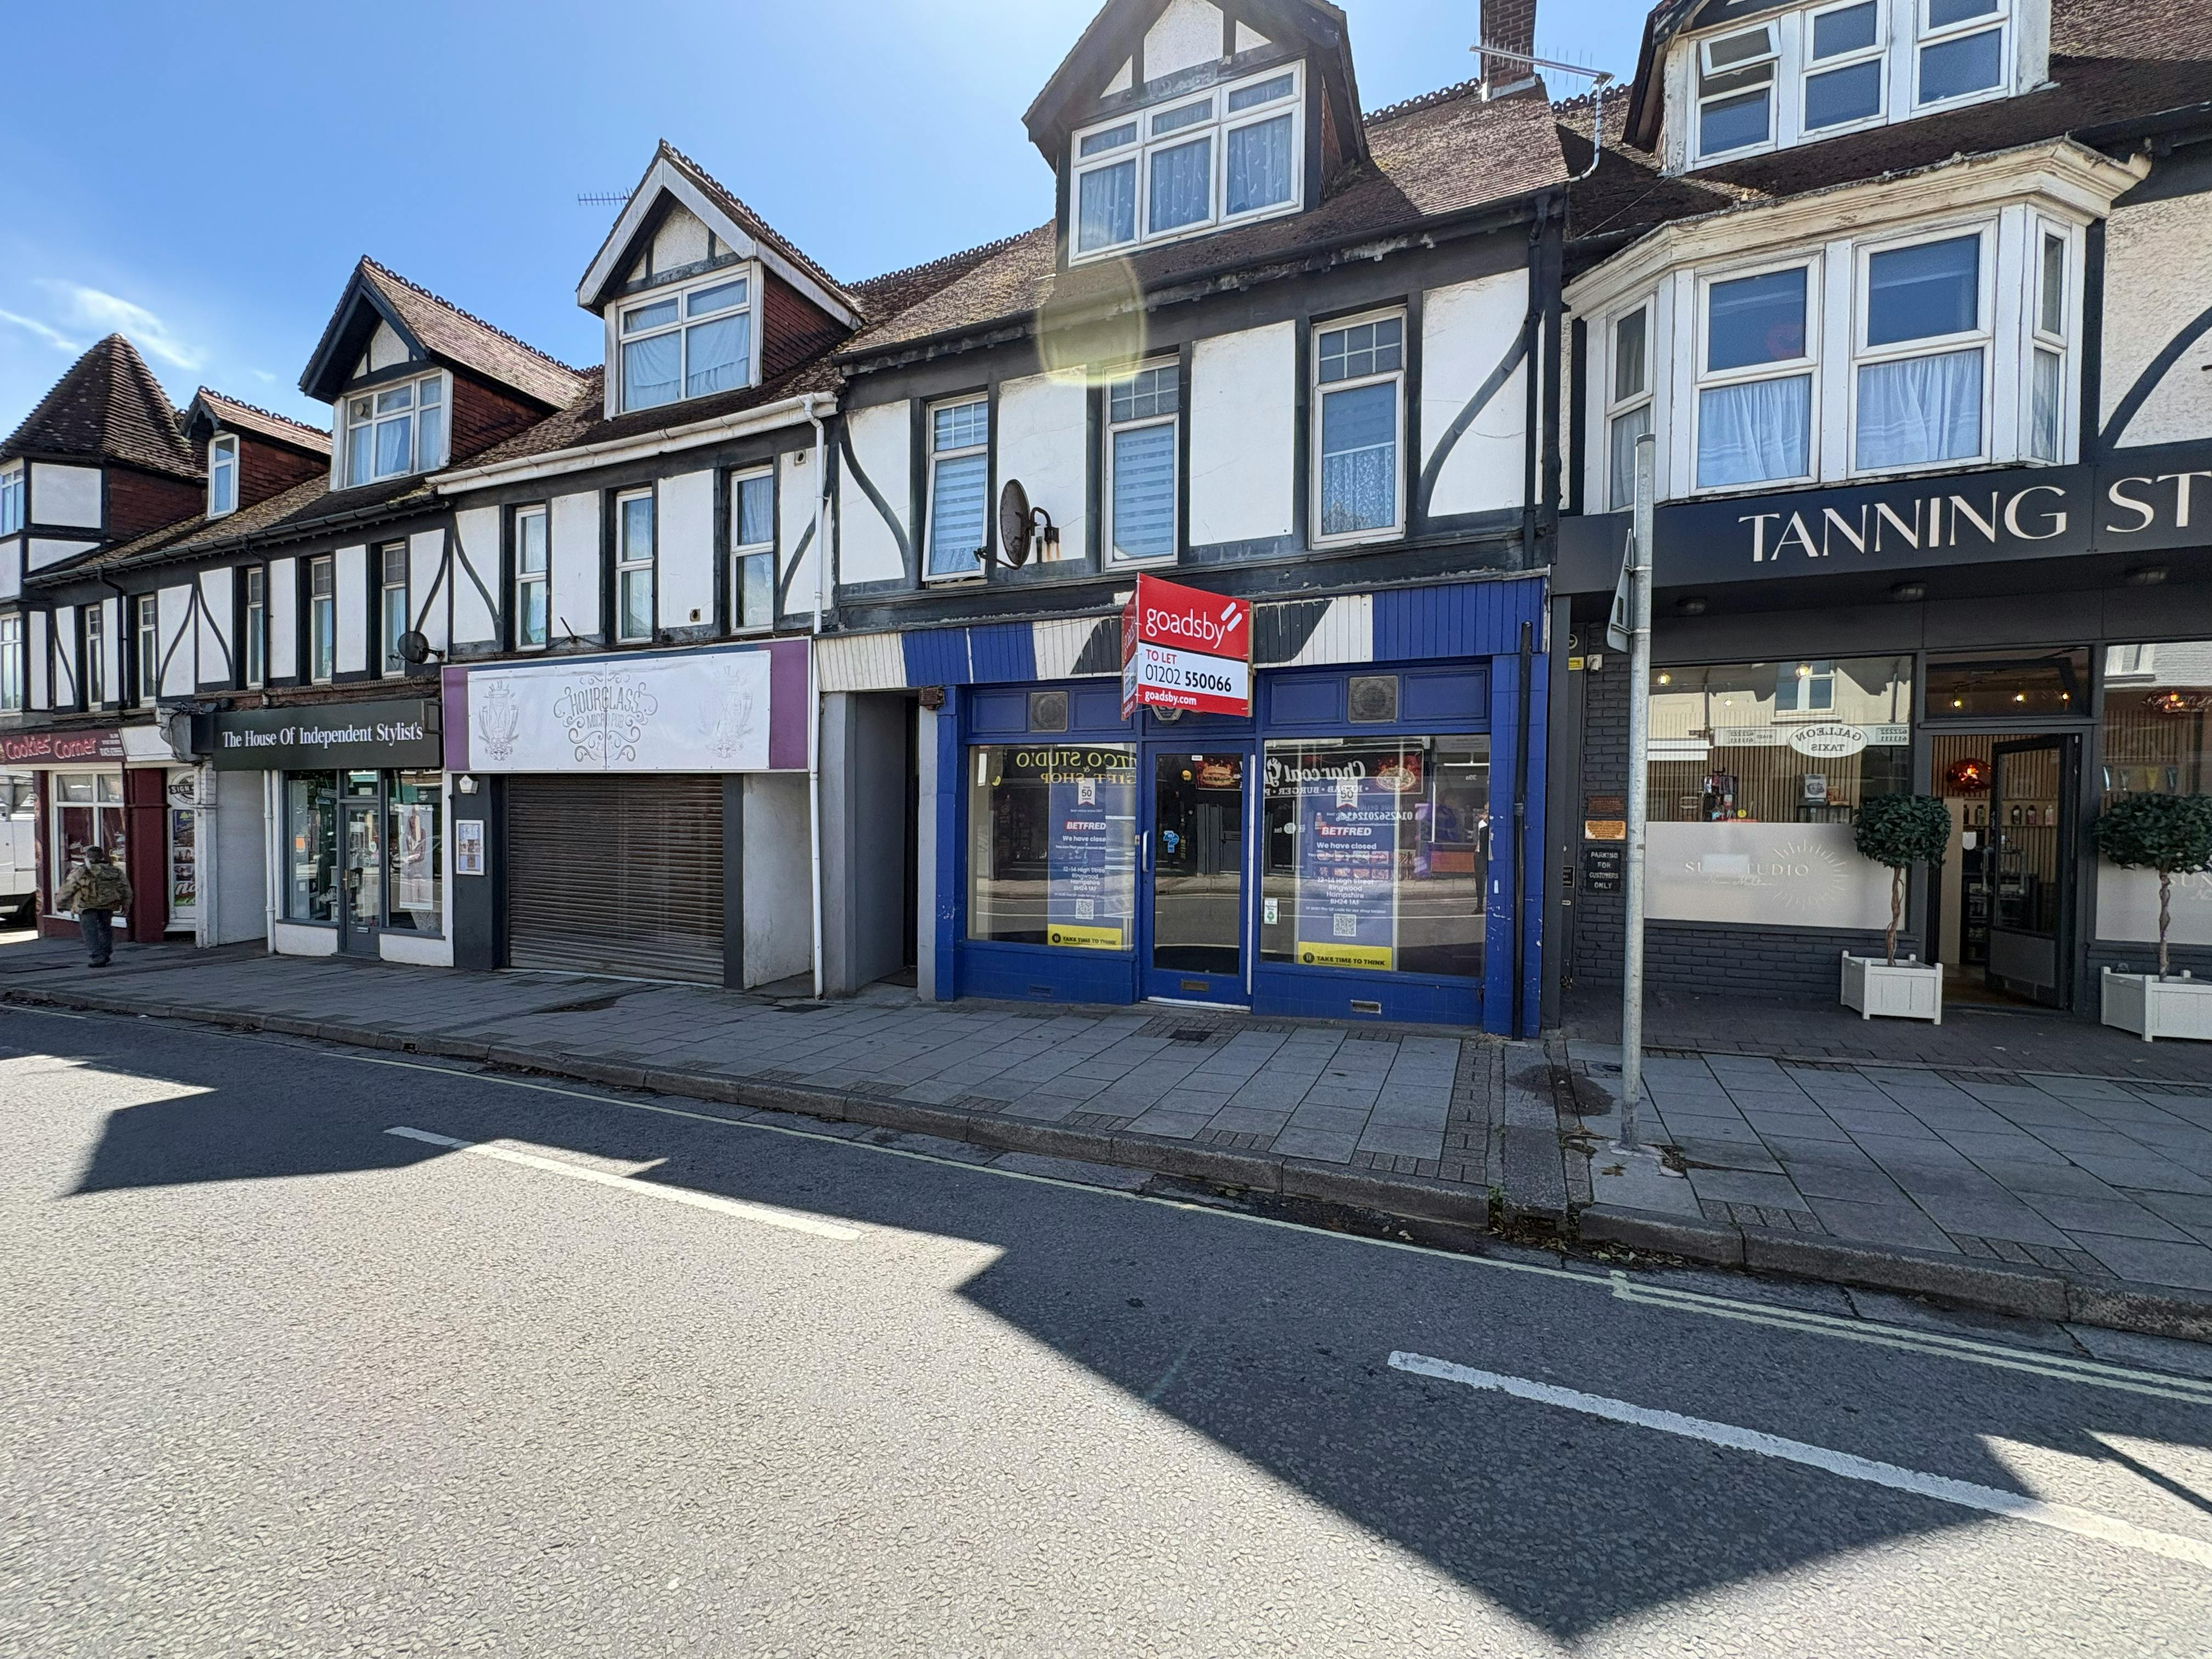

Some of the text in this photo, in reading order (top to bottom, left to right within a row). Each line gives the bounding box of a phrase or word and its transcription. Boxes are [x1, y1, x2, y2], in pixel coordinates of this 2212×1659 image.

[1738, 471, 2212, 562] TANNING ST
[1146, 608, 1226, 649] goadsby
[1146, 649, 1177, 665] TO LET
[1146, 664, 1181, 685] 01202
[1185, 671, 1232, 692] 550066
[570, 686, 640, 716] HOURGLASS
[1145, 690, 1197, 706] goadsby.com
[612, 713, 624, 729] PUB
[222, 722, 423, 749] The House Of Independent Stylist's
[54, 737, 97, 759] Corner
[171, 785, 189, 793] SIGN
[1081, 789, 1092, 797] 50
[1340, 791, 1354, 799] 50
[1066, 822, 1106, 830] BETFRED
[1322, 827, 1372, 836] BETFRED
